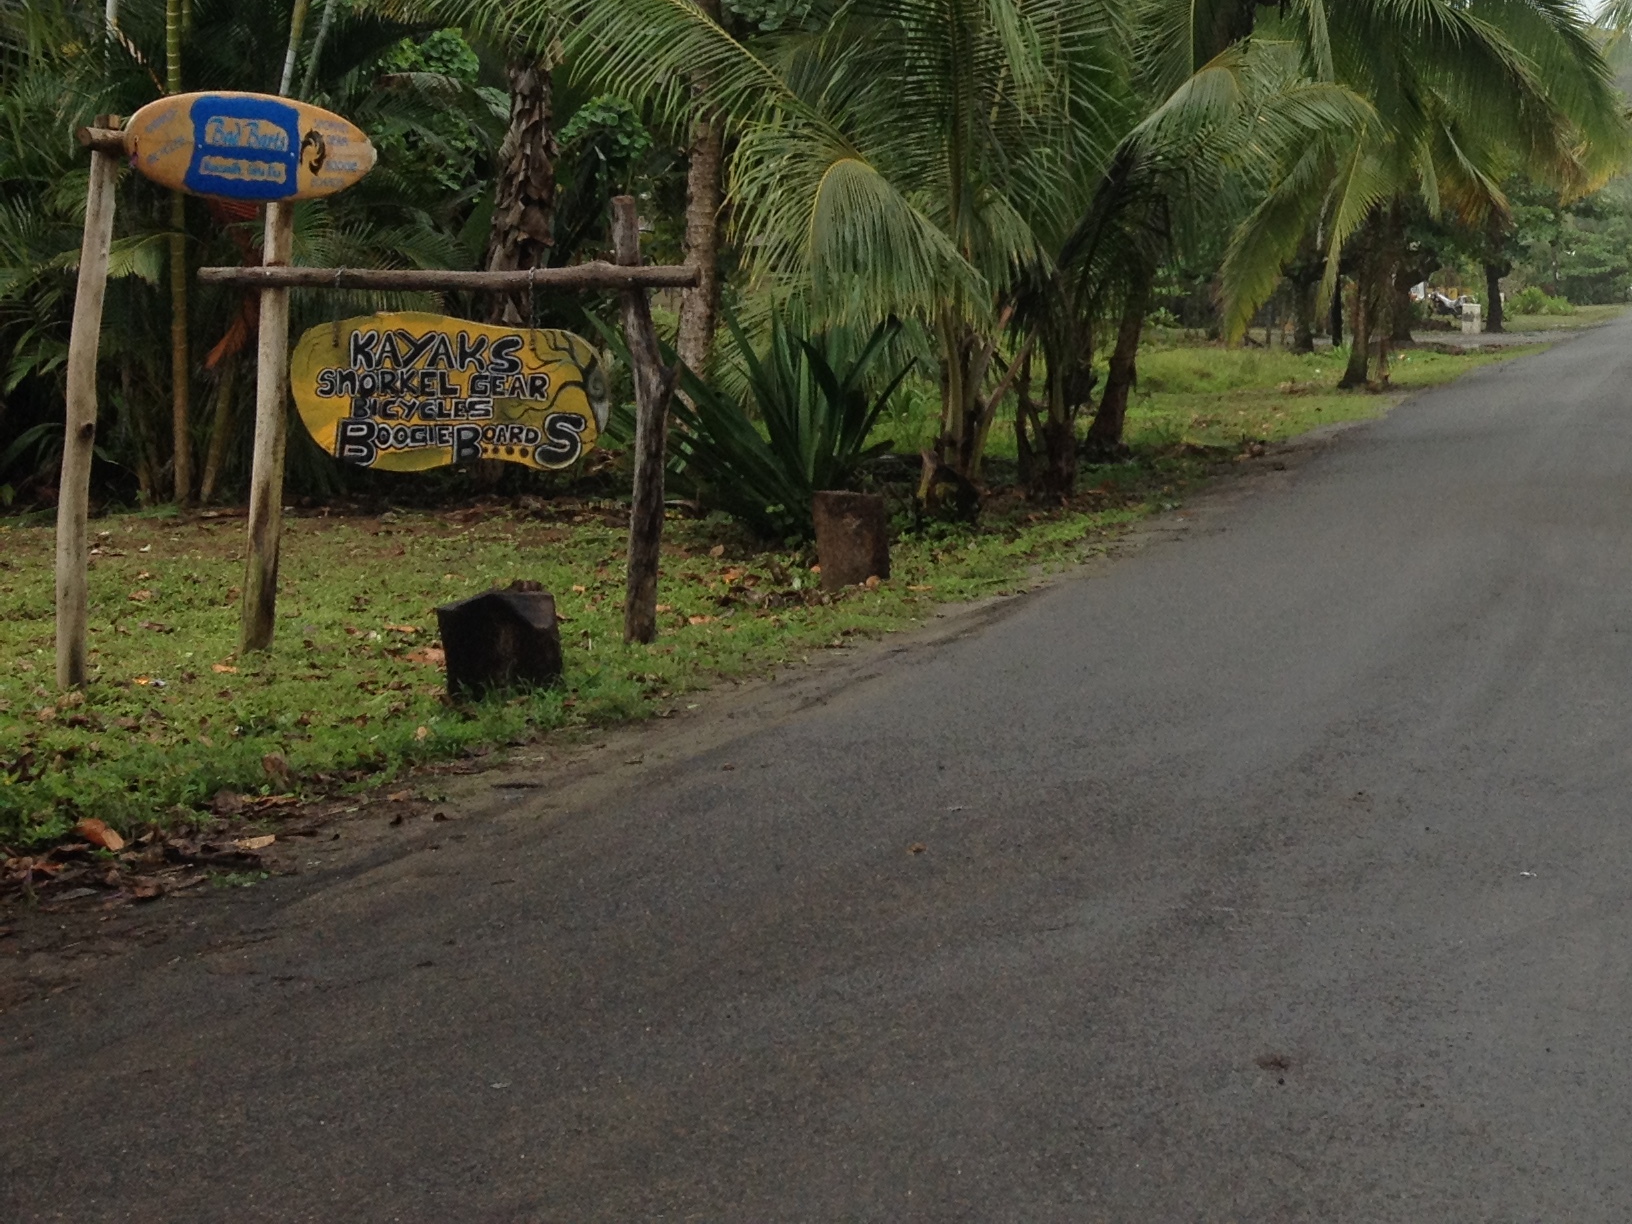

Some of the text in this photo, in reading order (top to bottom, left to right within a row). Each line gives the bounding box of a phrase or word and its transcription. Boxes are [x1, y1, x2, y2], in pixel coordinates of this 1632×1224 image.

[349, 329, 524, 375] KAYAKS
[468, 372, 549, 400] GEAR
[349, 397, 494, 421] BICYCLES
[335, 417, 453, 467] BOOGIE
